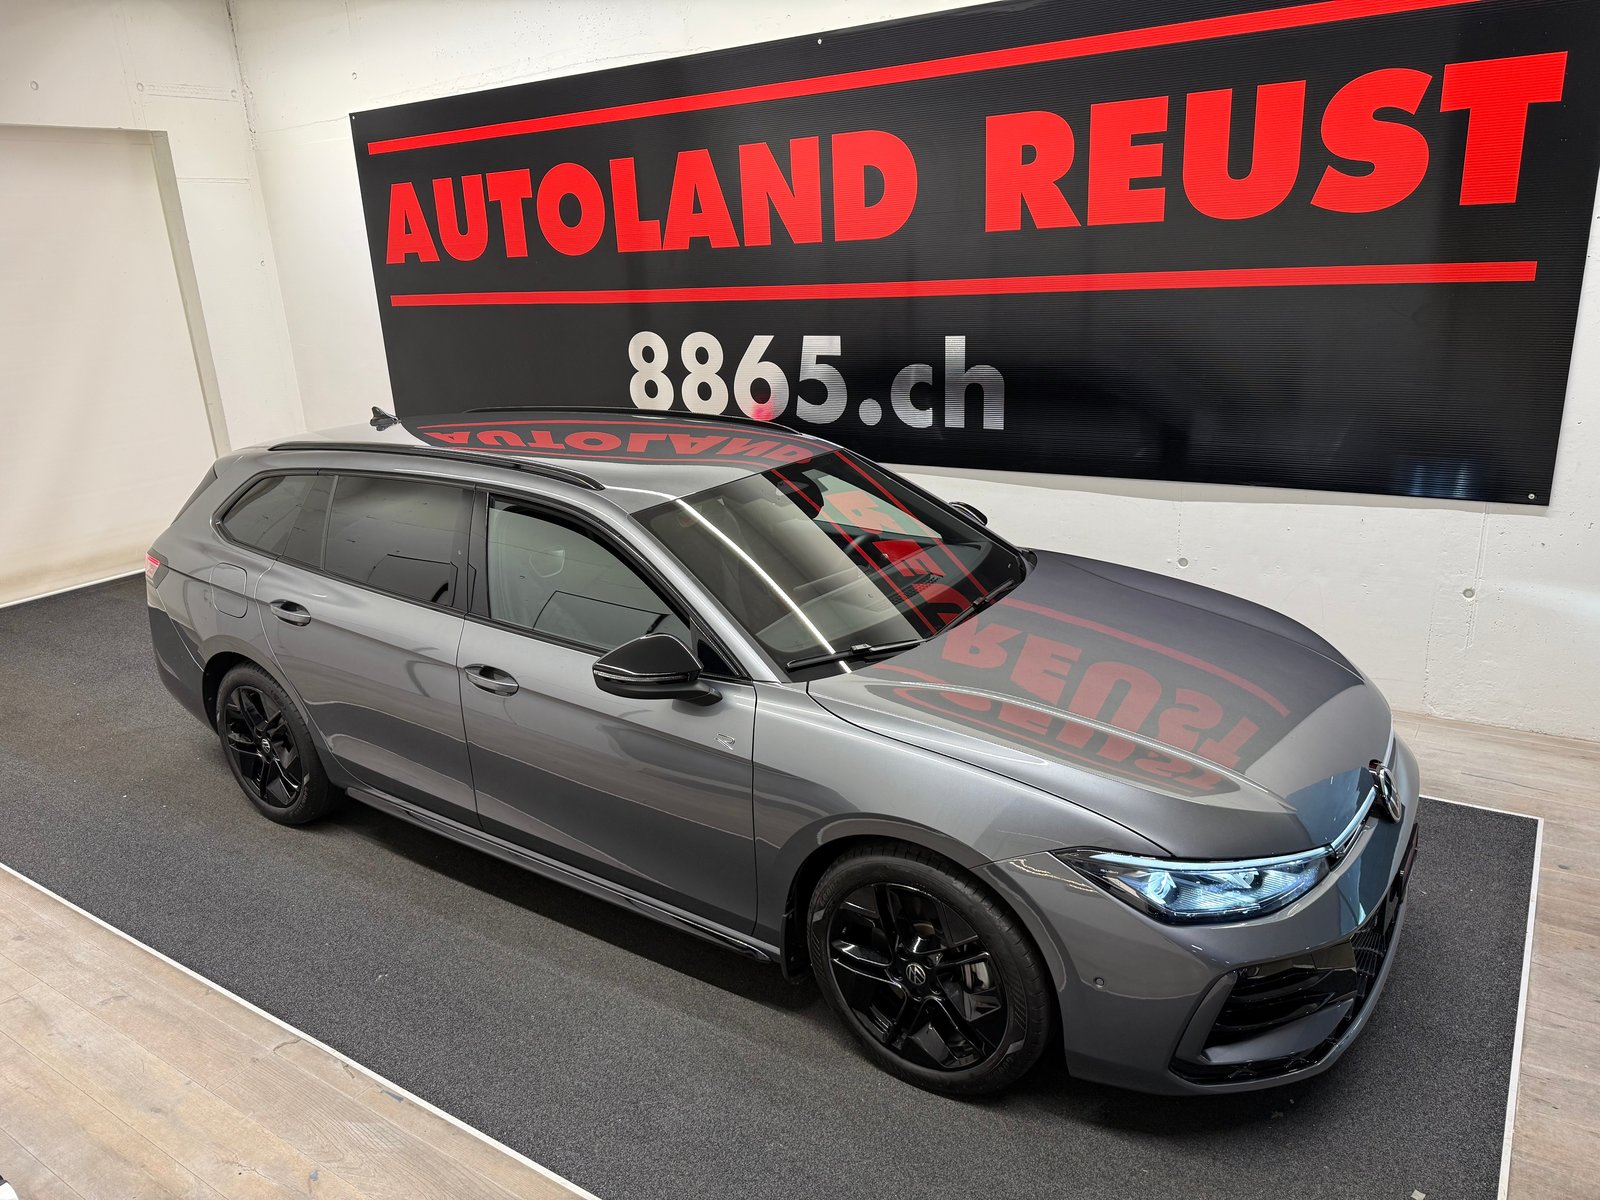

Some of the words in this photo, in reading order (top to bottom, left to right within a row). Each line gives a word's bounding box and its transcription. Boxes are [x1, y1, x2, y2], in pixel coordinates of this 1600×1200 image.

[385, 130, 919, 266] AUTOLAND
[985, 51, 1569, 233] REUST
[627, 330, 1006, 430] 8865.ch
